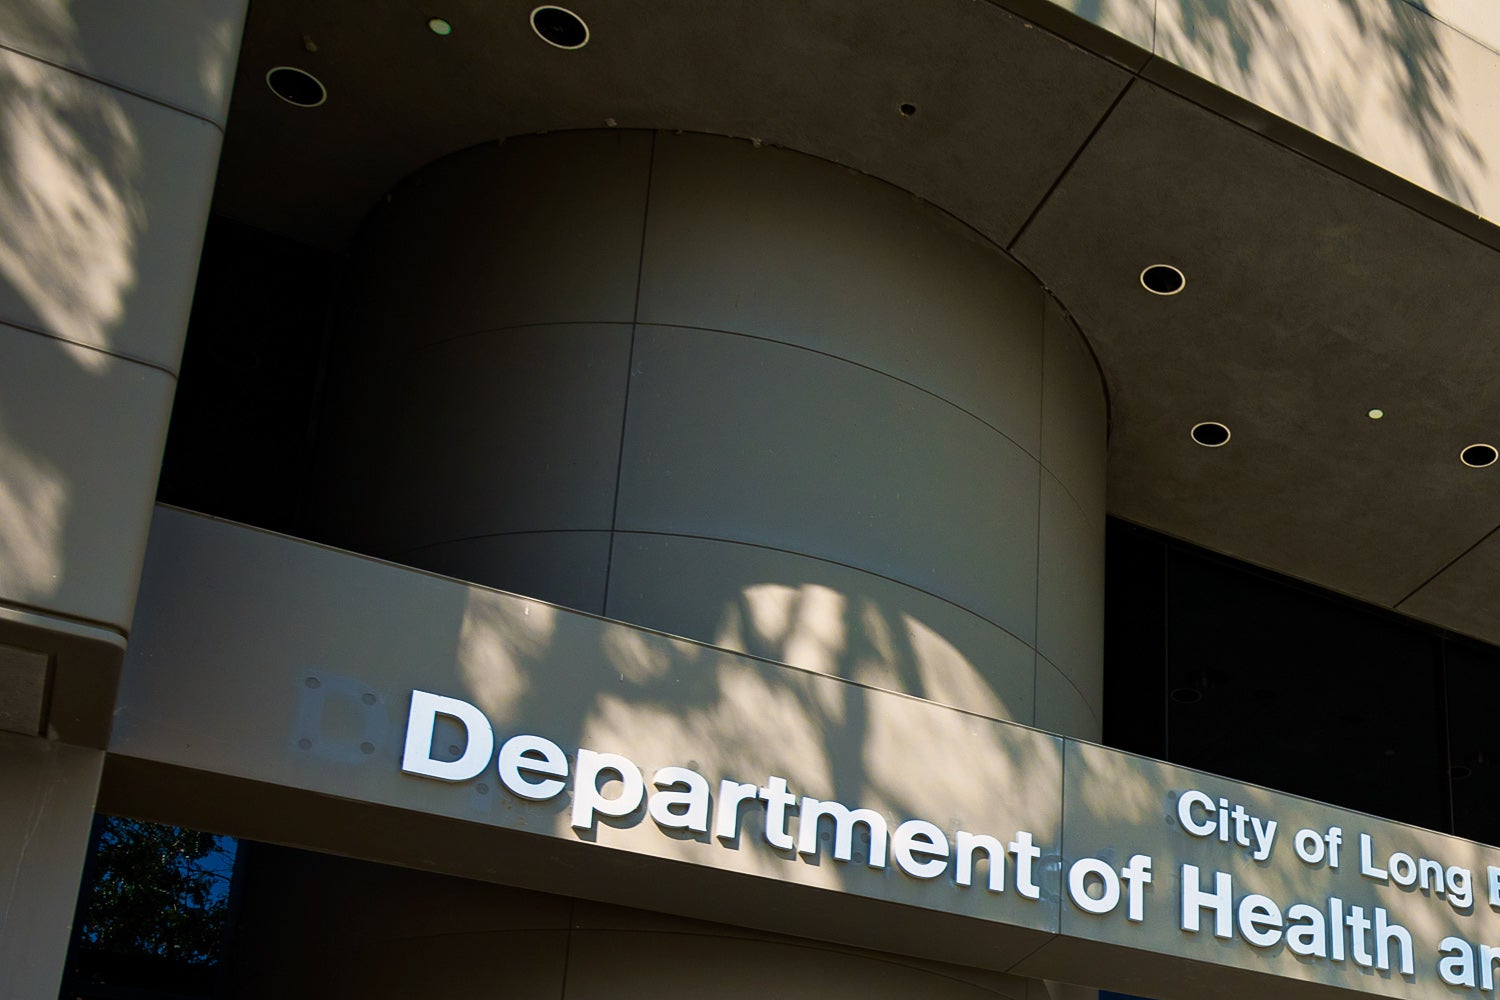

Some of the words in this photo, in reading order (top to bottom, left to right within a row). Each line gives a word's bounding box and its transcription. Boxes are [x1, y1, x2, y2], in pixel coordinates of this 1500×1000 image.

[401, 689, 1040, 900] Department
[1067, 854, 1152, 922] of
[1180, 864, 1415, 975] Health
[1177, 789, 1278, 861] City
[1294, 825, 1342, 869] of
[1360, 833, 1474, 909] Long
